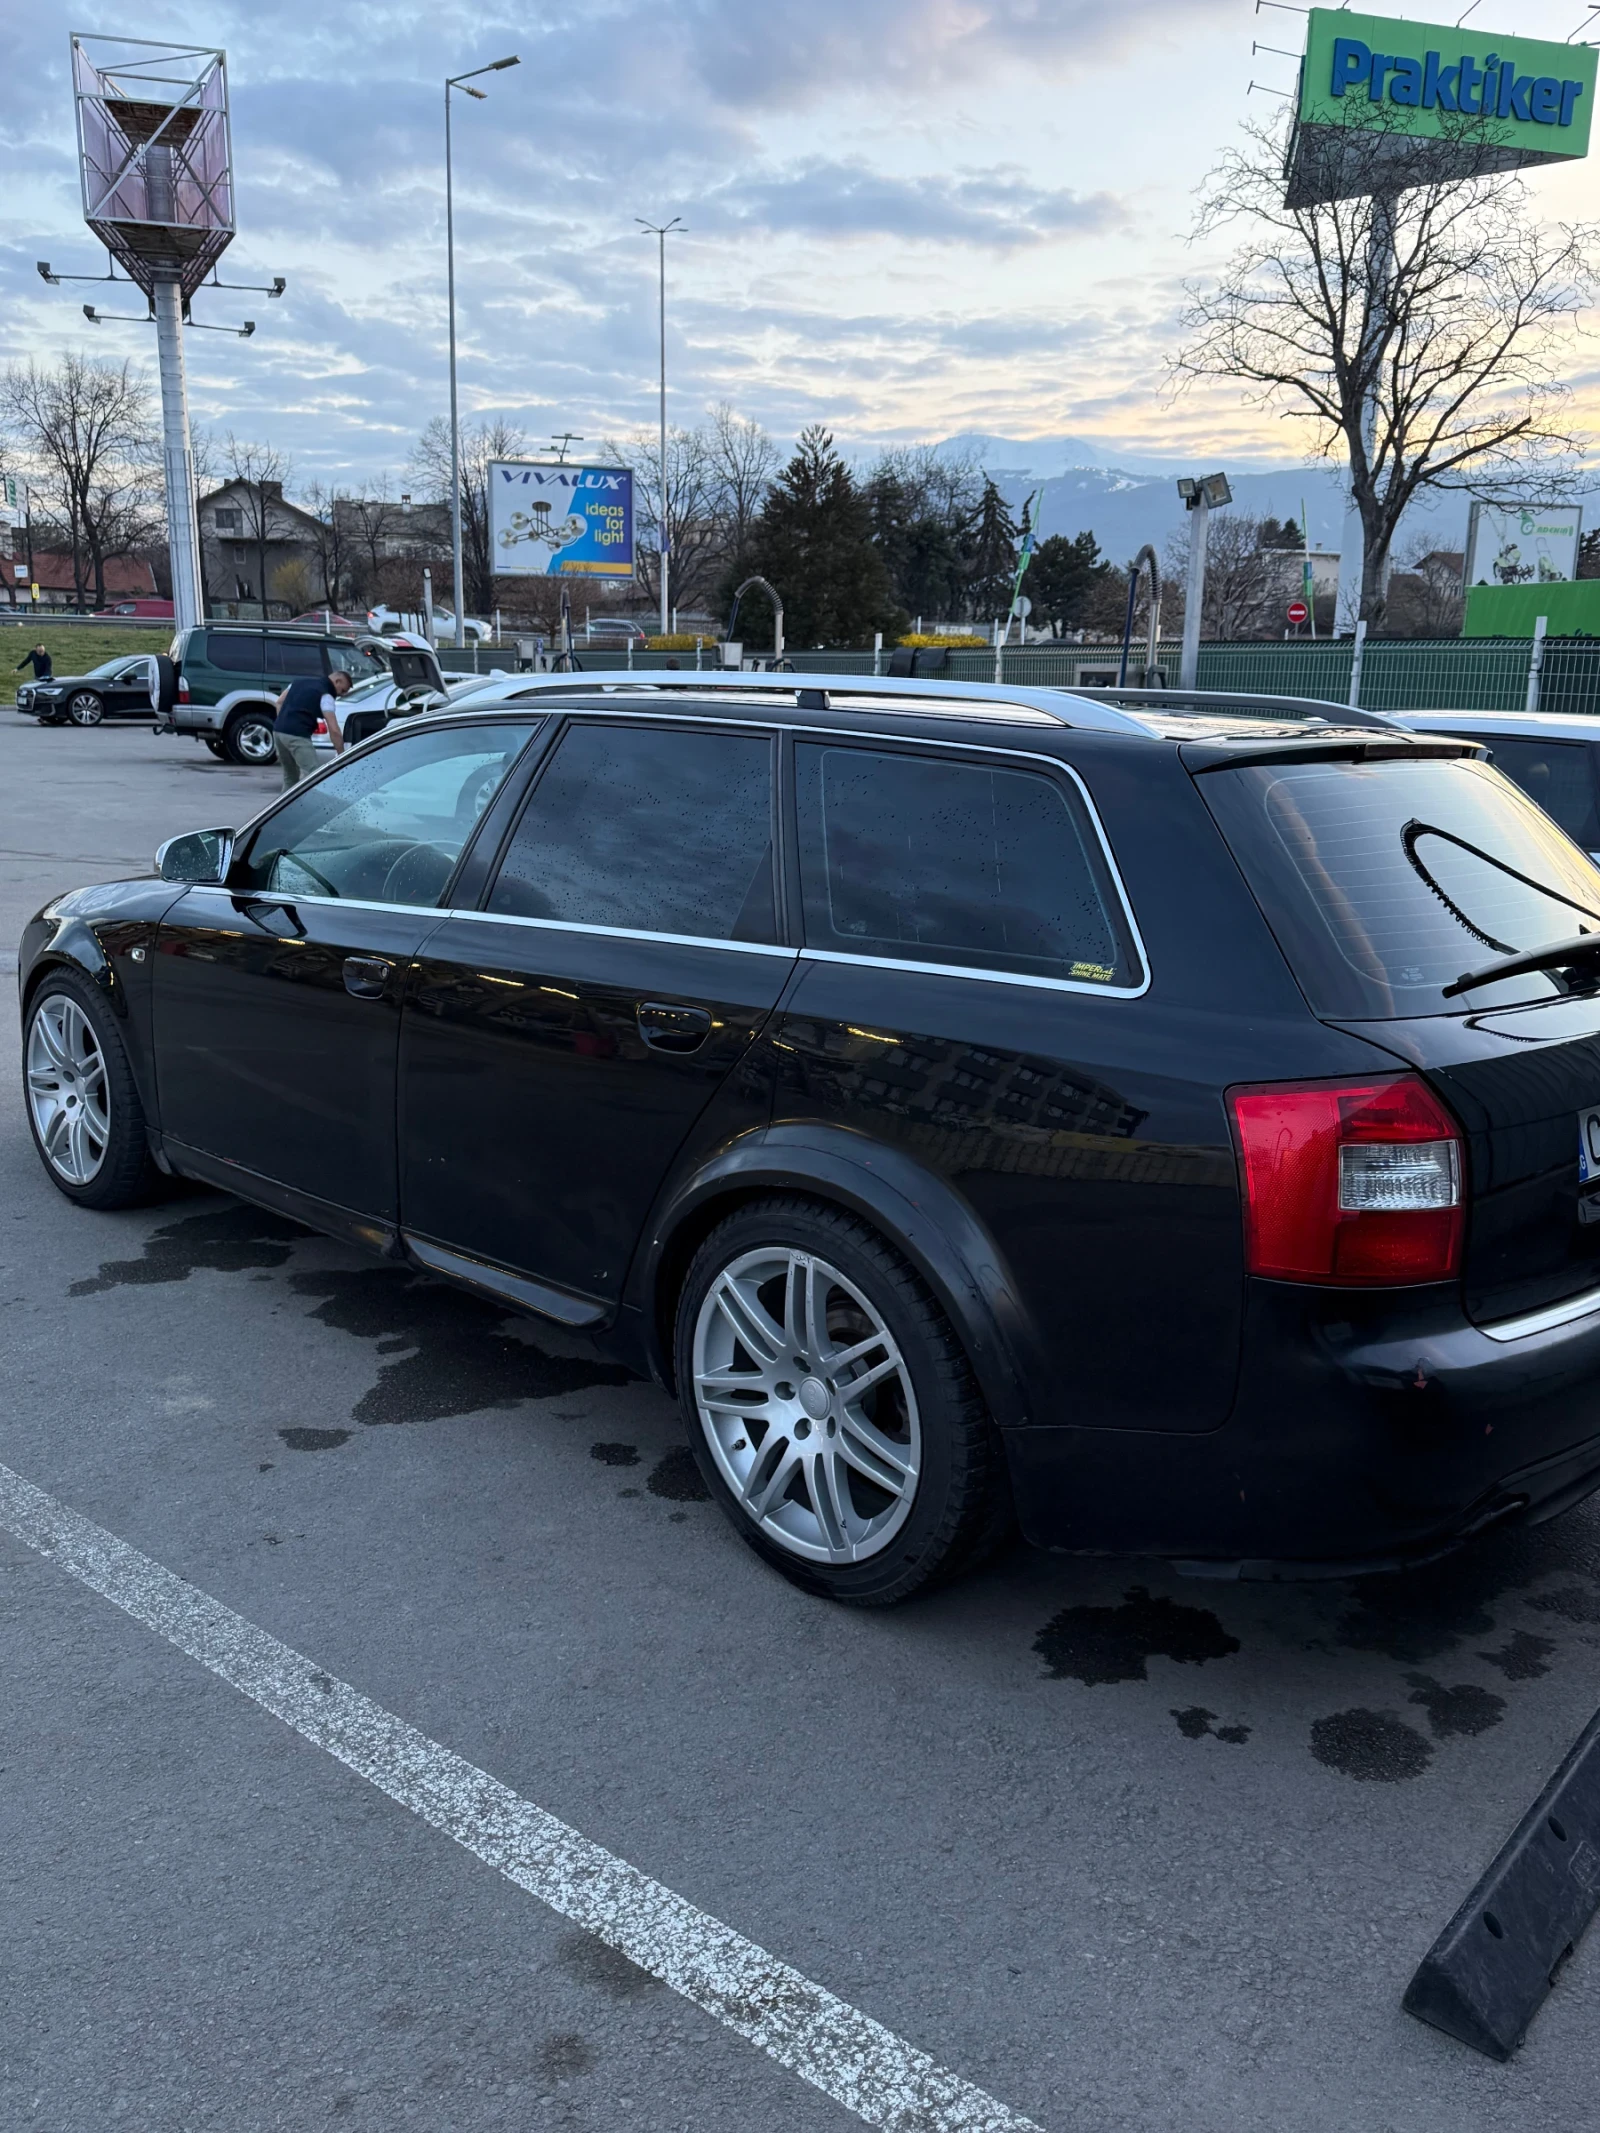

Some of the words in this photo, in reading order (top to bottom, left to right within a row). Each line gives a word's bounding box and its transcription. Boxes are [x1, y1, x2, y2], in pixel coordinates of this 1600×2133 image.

[1330, 37, 1584, 127] Praktiker
[501, 470, 622, 490] VIVALUX
[586, 503, 624, 517] ideas
[605, 517, 624, 529] for
[594, 530, 624, 546] light
